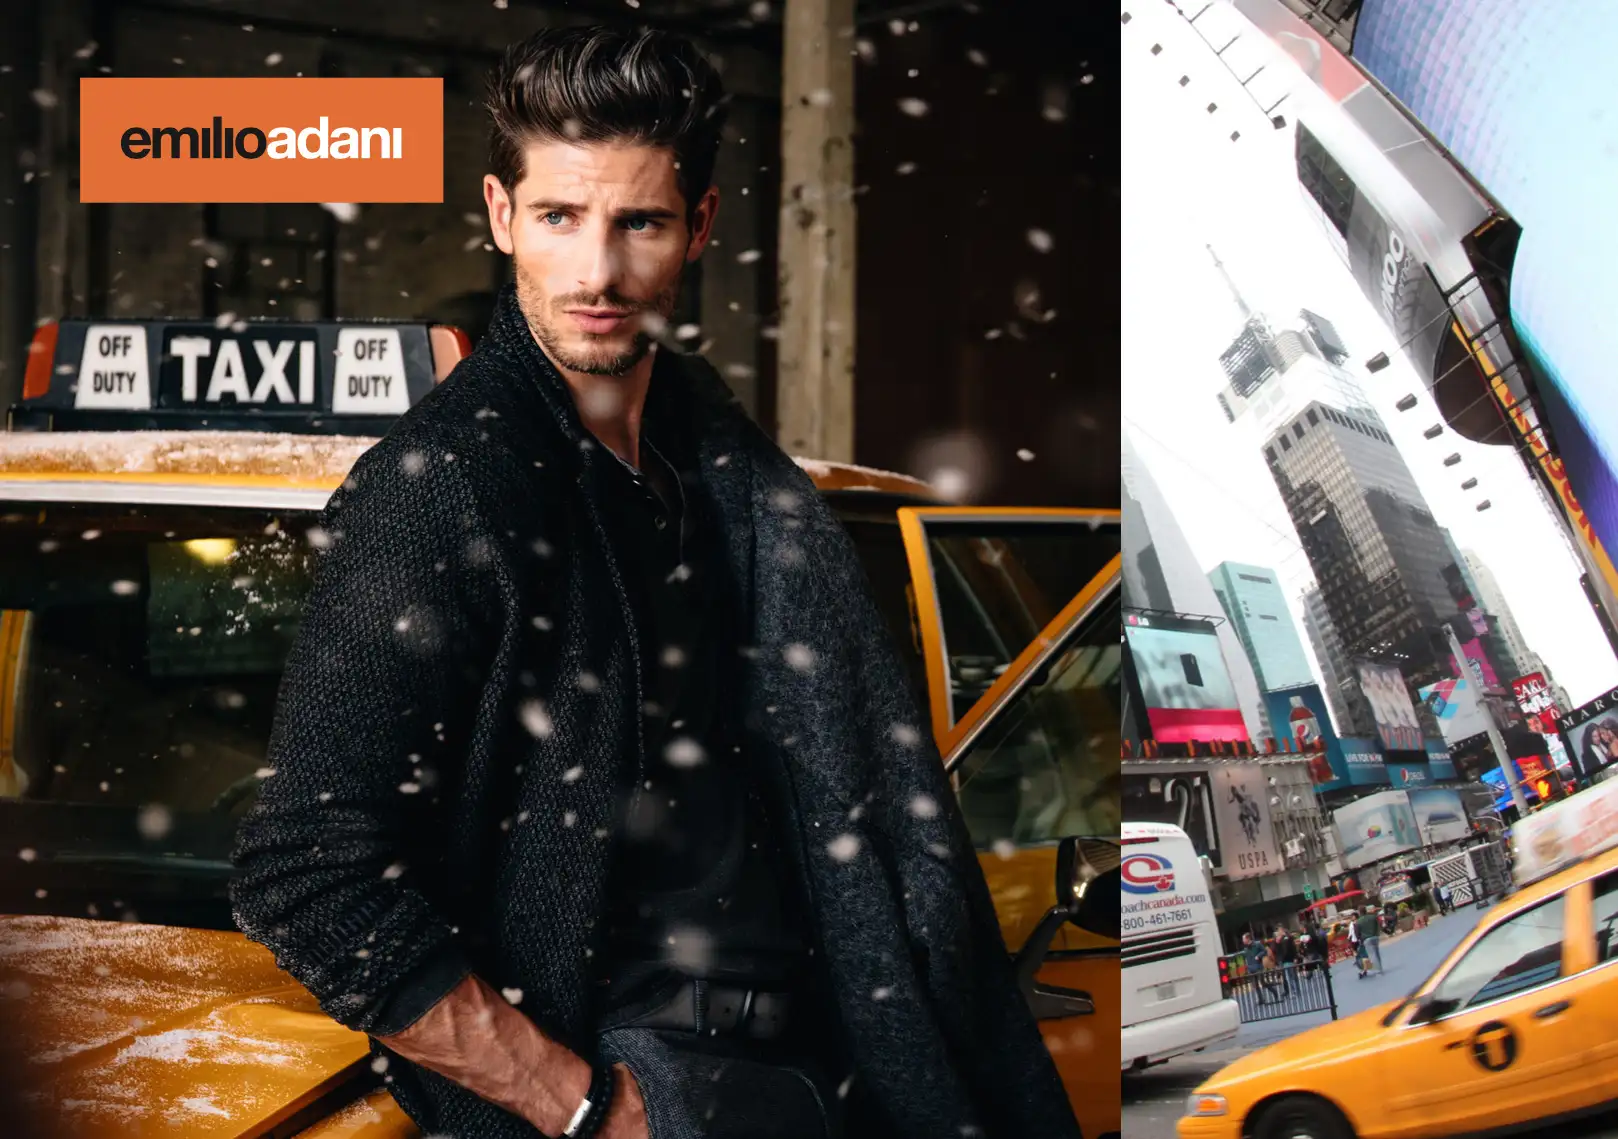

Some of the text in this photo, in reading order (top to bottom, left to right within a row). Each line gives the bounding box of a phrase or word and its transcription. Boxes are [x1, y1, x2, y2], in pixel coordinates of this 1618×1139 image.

[99, 335, 132, 357] OFF
[354, 338, 388, 361] OFF
[170, 336, 316, 404] TAXI
[93, 372, 137, 395] DUTY
[348, 375, 392, 398] DUTY
[1238, 851, 1269, 870] USPA
[1121, 894, 1206, 914] oachcanada.com
[1121, 909, 1191, 930] -800-461-7661
